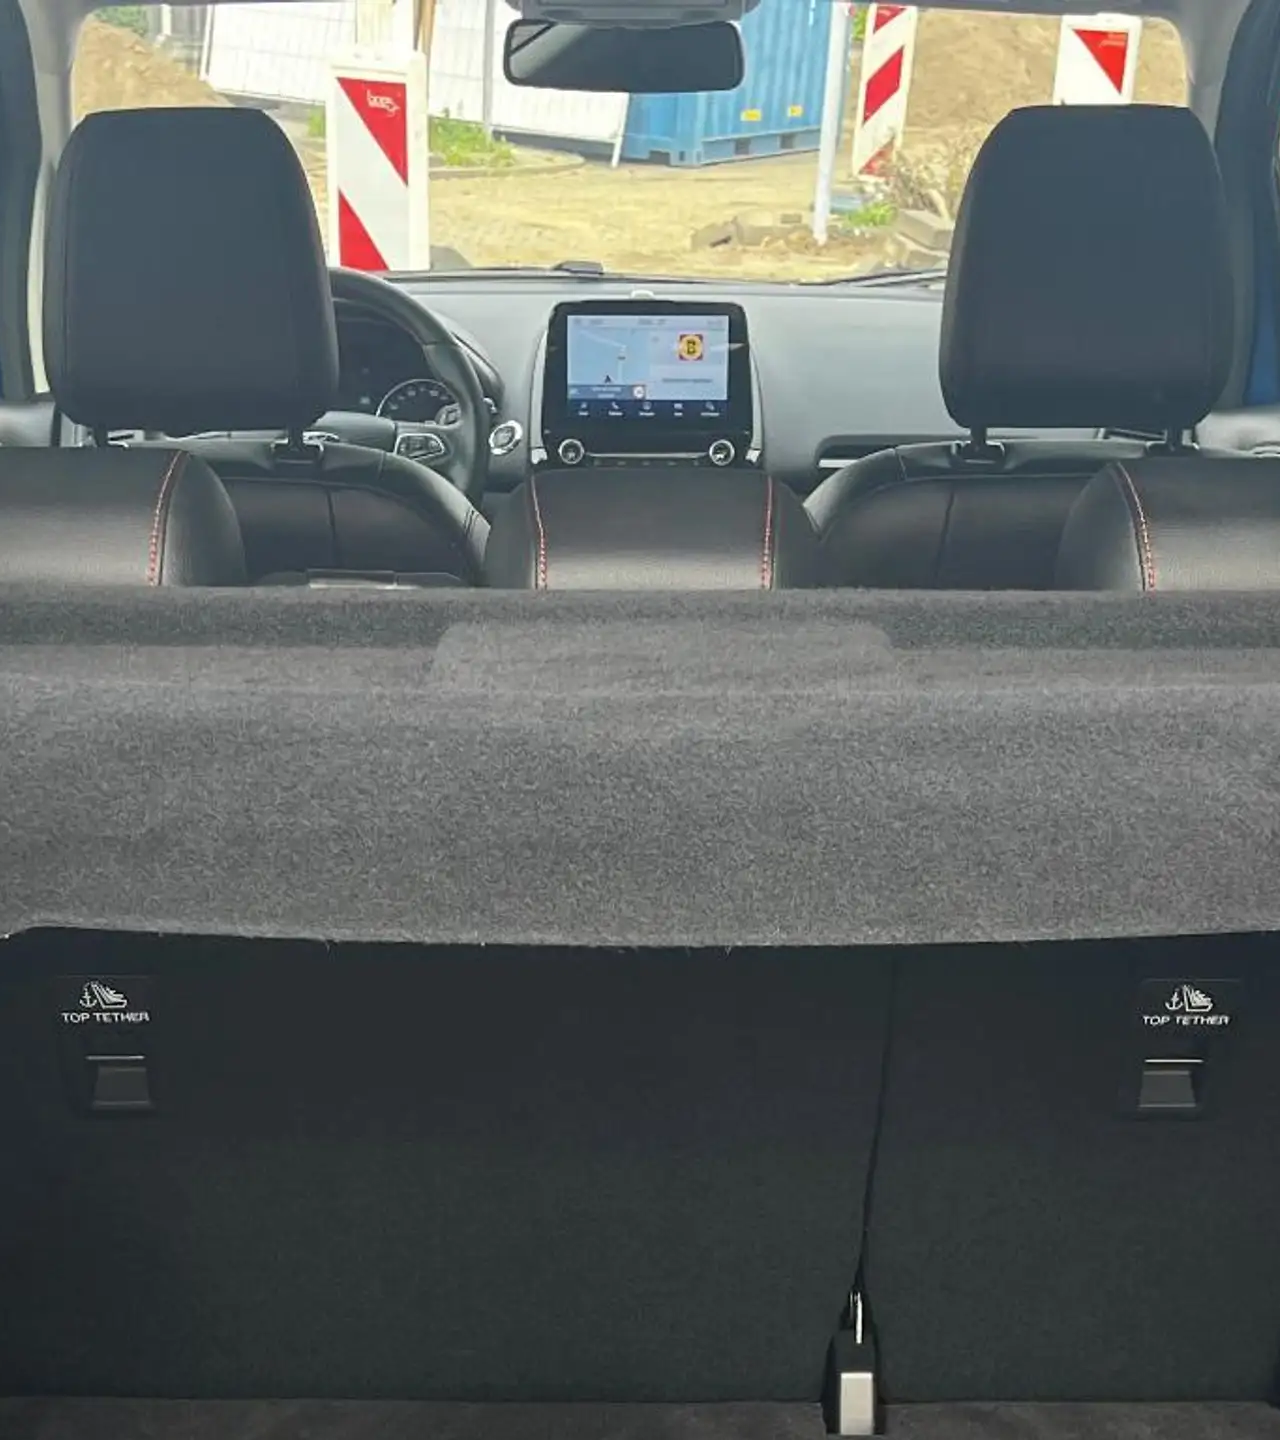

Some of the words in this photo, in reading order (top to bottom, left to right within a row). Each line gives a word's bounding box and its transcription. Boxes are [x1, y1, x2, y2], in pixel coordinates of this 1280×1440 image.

[61, 1012, 90, 1023] TOP
[93, 1012, 150, 1023] TETHER
[1142, 1015, 1170, 1026] TOP
[1176, 1015, 1230, 1026] TETHER
